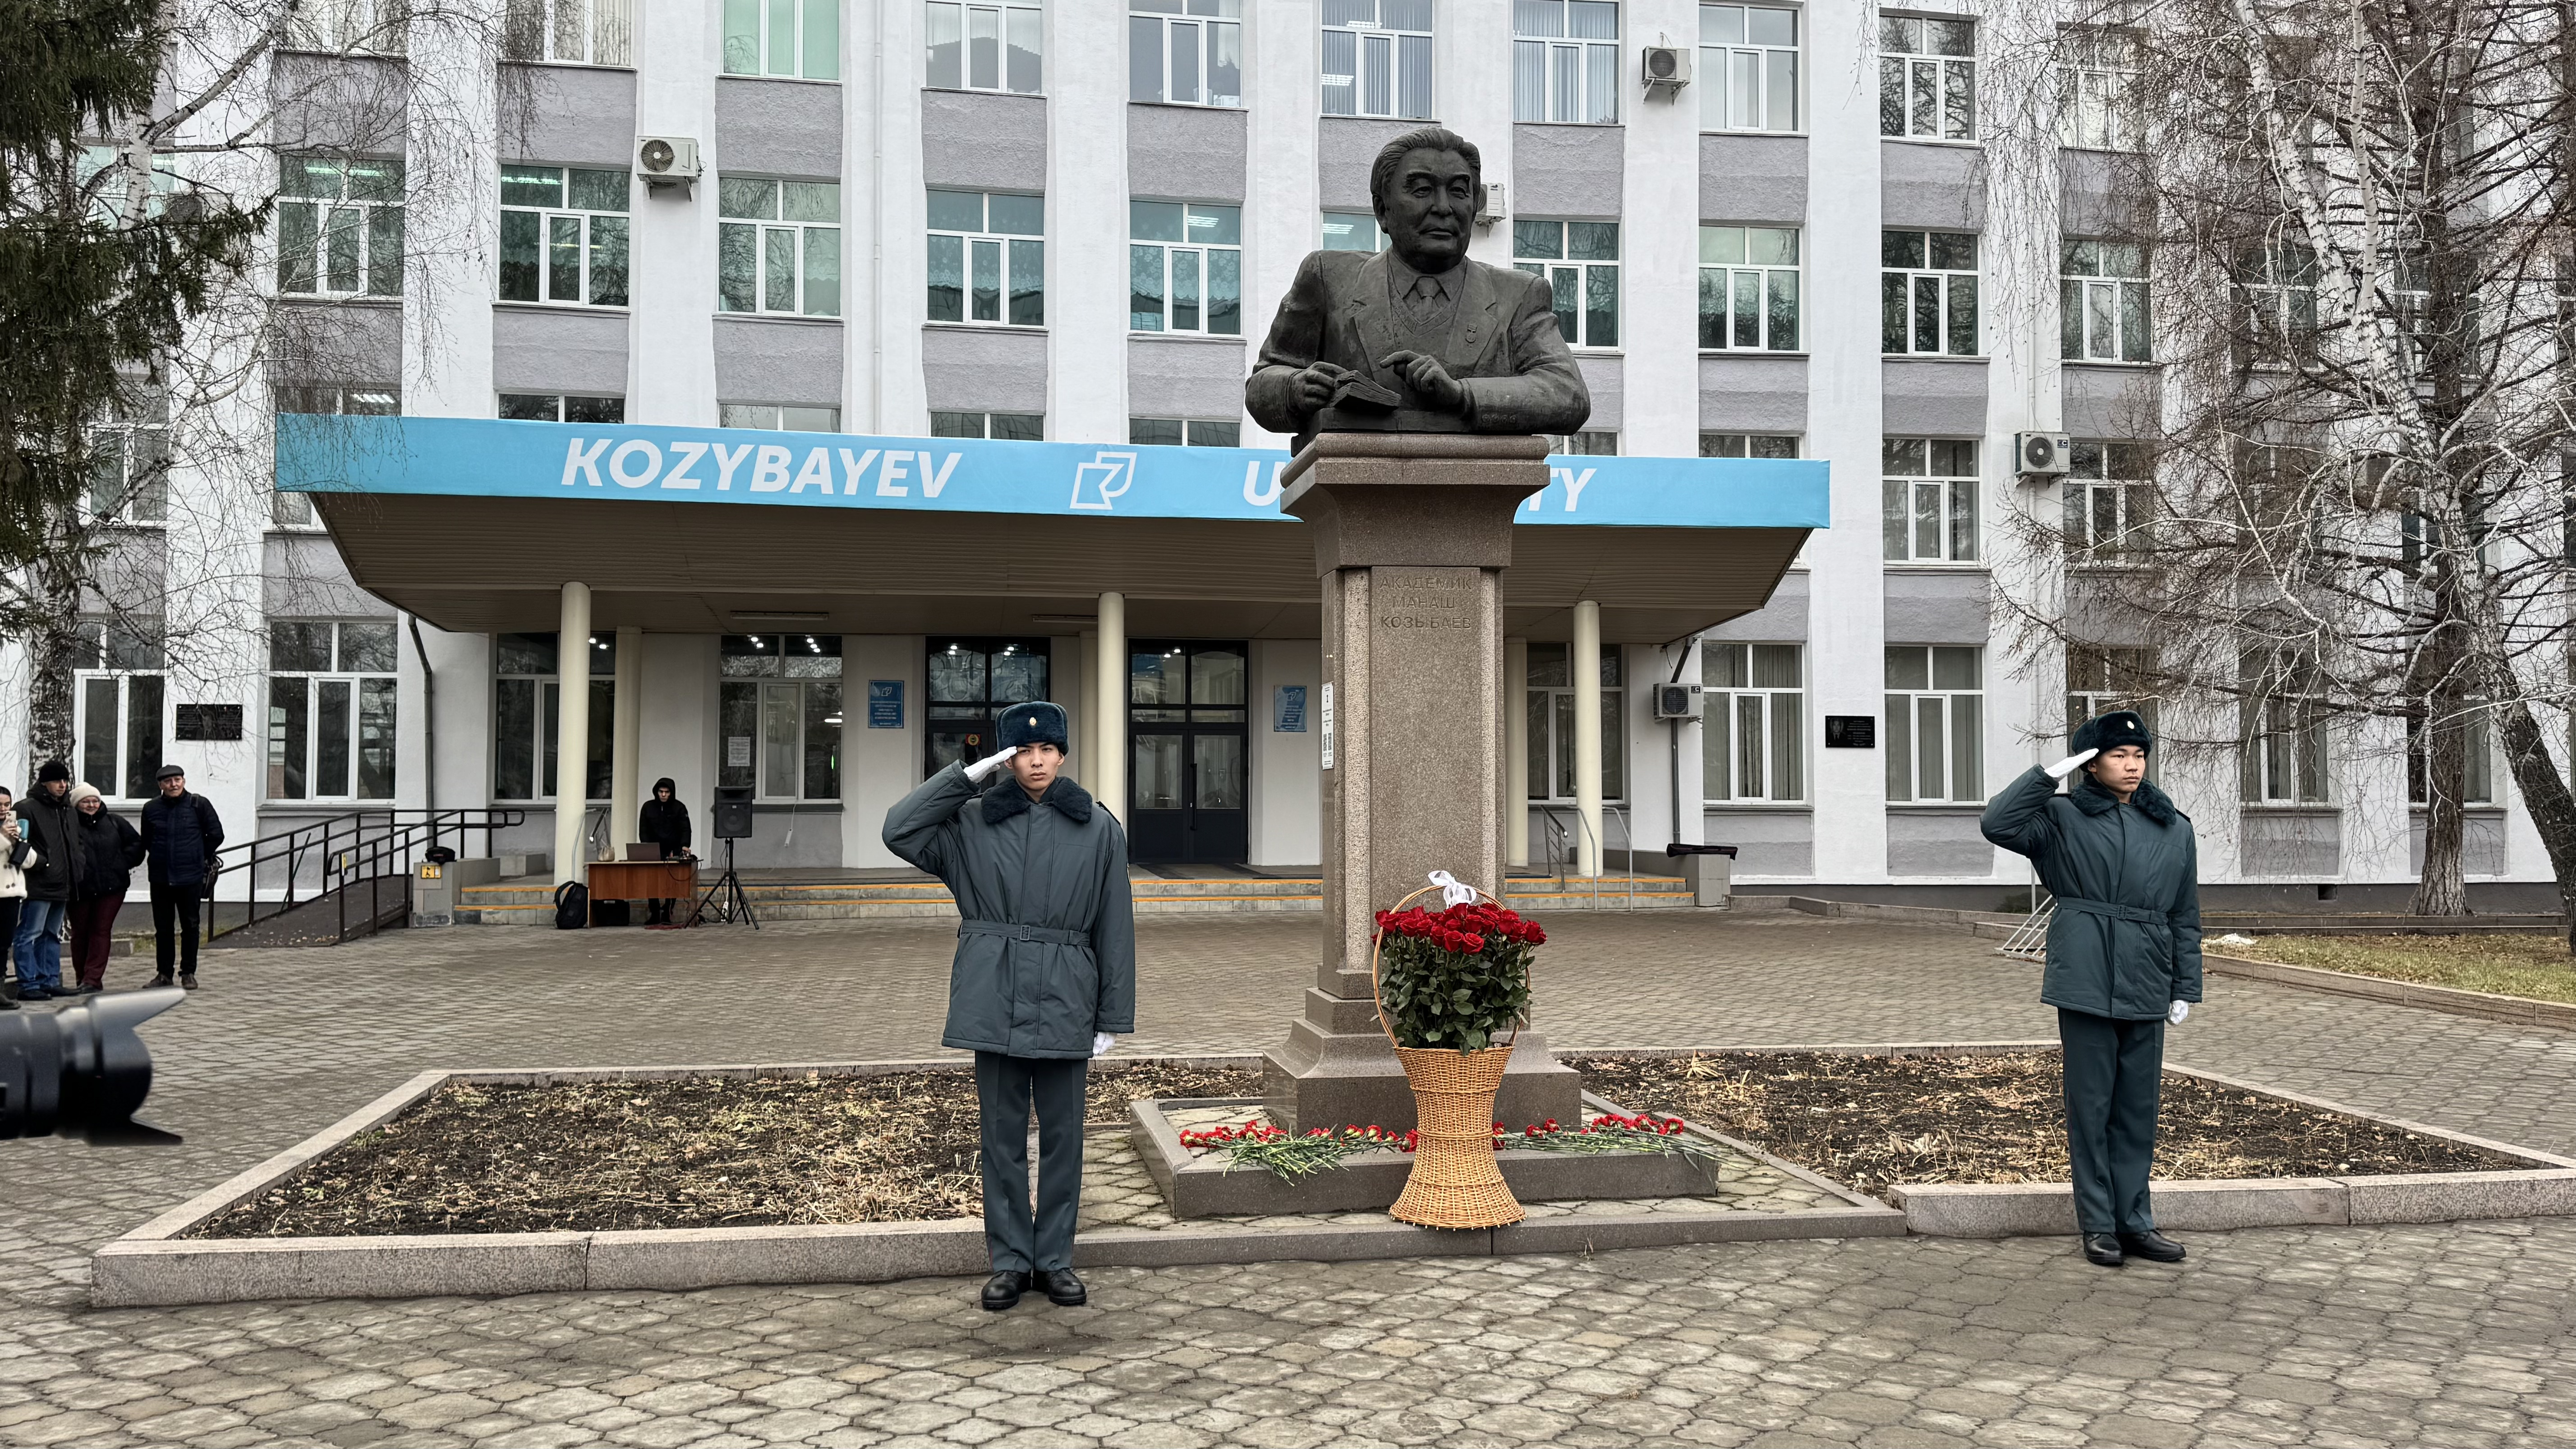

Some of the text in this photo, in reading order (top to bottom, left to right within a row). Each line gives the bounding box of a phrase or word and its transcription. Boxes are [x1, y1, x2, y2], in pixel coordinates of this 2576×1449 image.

[561, 437, 963, 498] KOZYBAYEV
[1380, 577, 1472, 590] АКАДЕМИК
[1393, 596, 1455, 608] МАНАШ
[1381, 616, 1471, 629] КОЗЫБАЕВ
